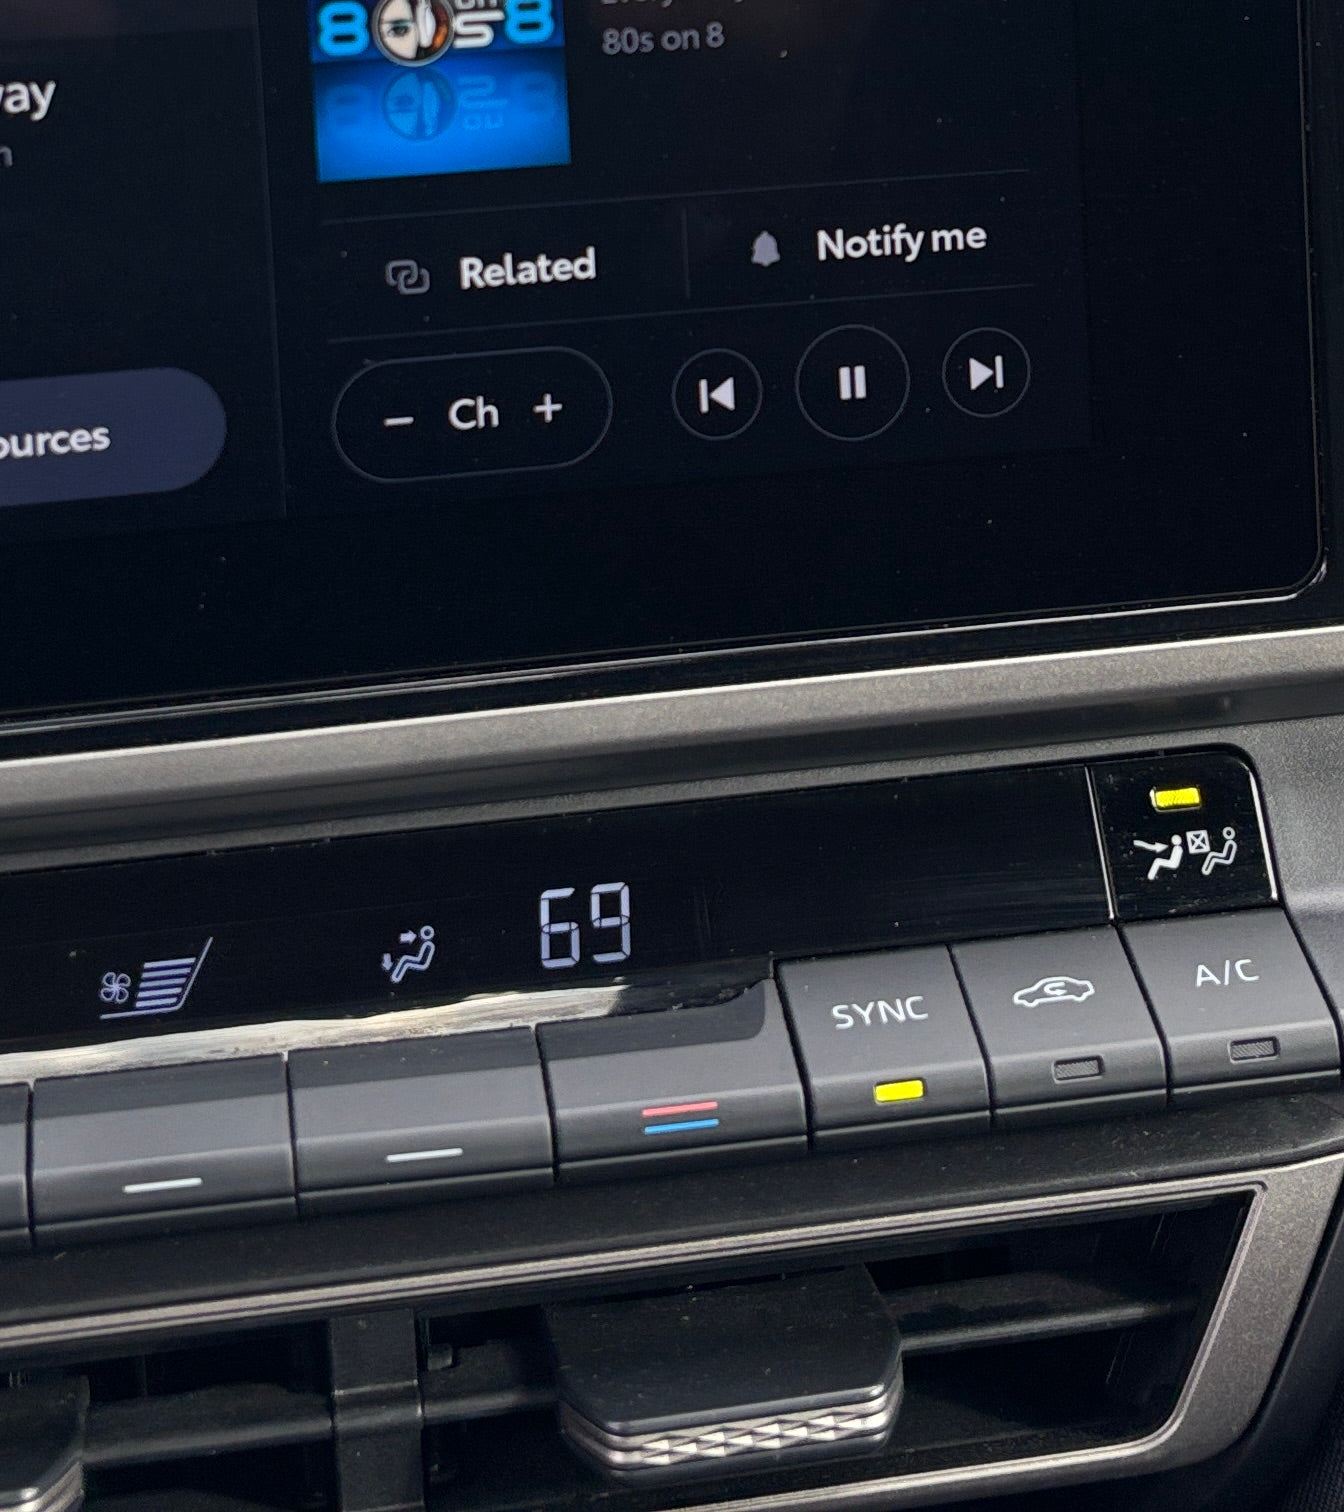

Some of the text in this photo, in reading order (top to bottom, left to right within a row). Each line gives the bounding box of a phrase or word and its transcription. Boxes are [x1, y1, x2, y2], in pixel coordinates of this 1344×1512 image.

[601, 21, 725, 55] 80s on 8
[816, 222, 987, 263] Notify me
[460, 246, 597, 290] Related
[448, 395, 500, 430] Ch
[539, 881, 631, 969] 69
[1195, 958, 1260, 988] A/C
[832, 995, 929, 1030] SYNC
